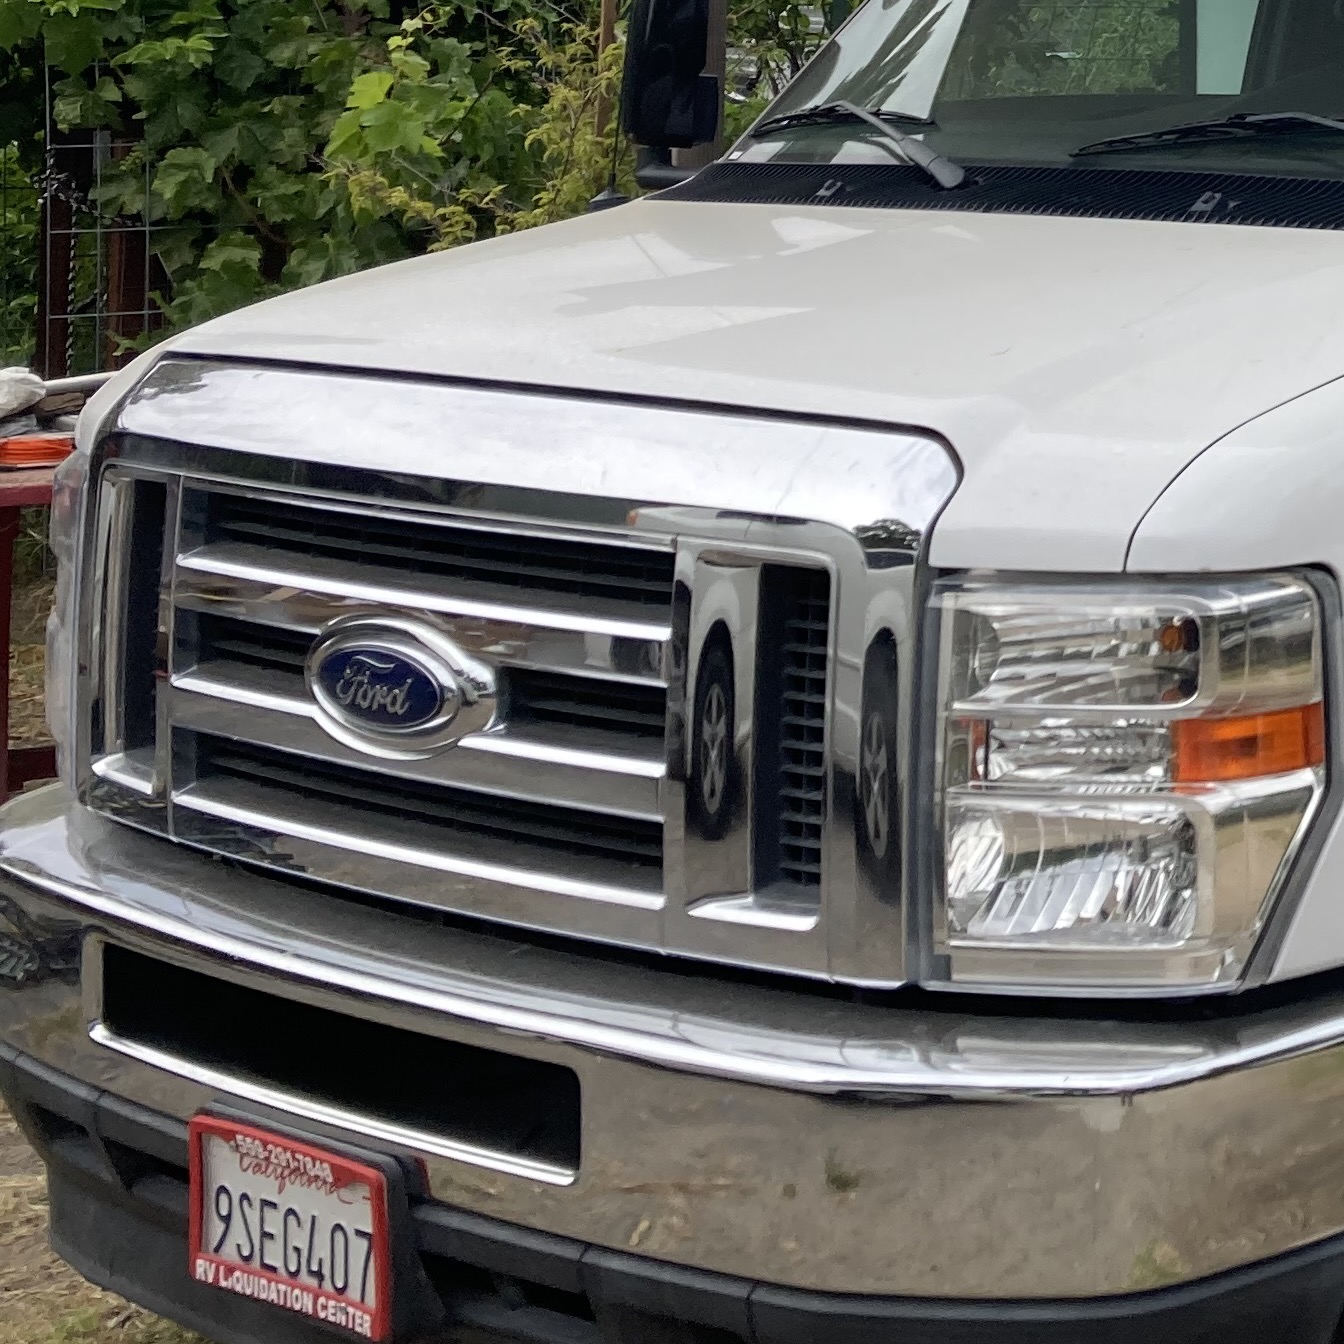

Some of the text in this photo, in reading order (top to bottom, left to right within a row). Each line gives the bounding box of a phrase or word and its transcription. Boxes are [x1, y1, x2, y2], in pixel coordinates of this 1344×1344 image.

[336, 656, 415, 715] Ford
[213, 1185, 373, 1304] 9SEG407
[195, 1258, 372, 1338] RV LIQUIDATION CENTER
